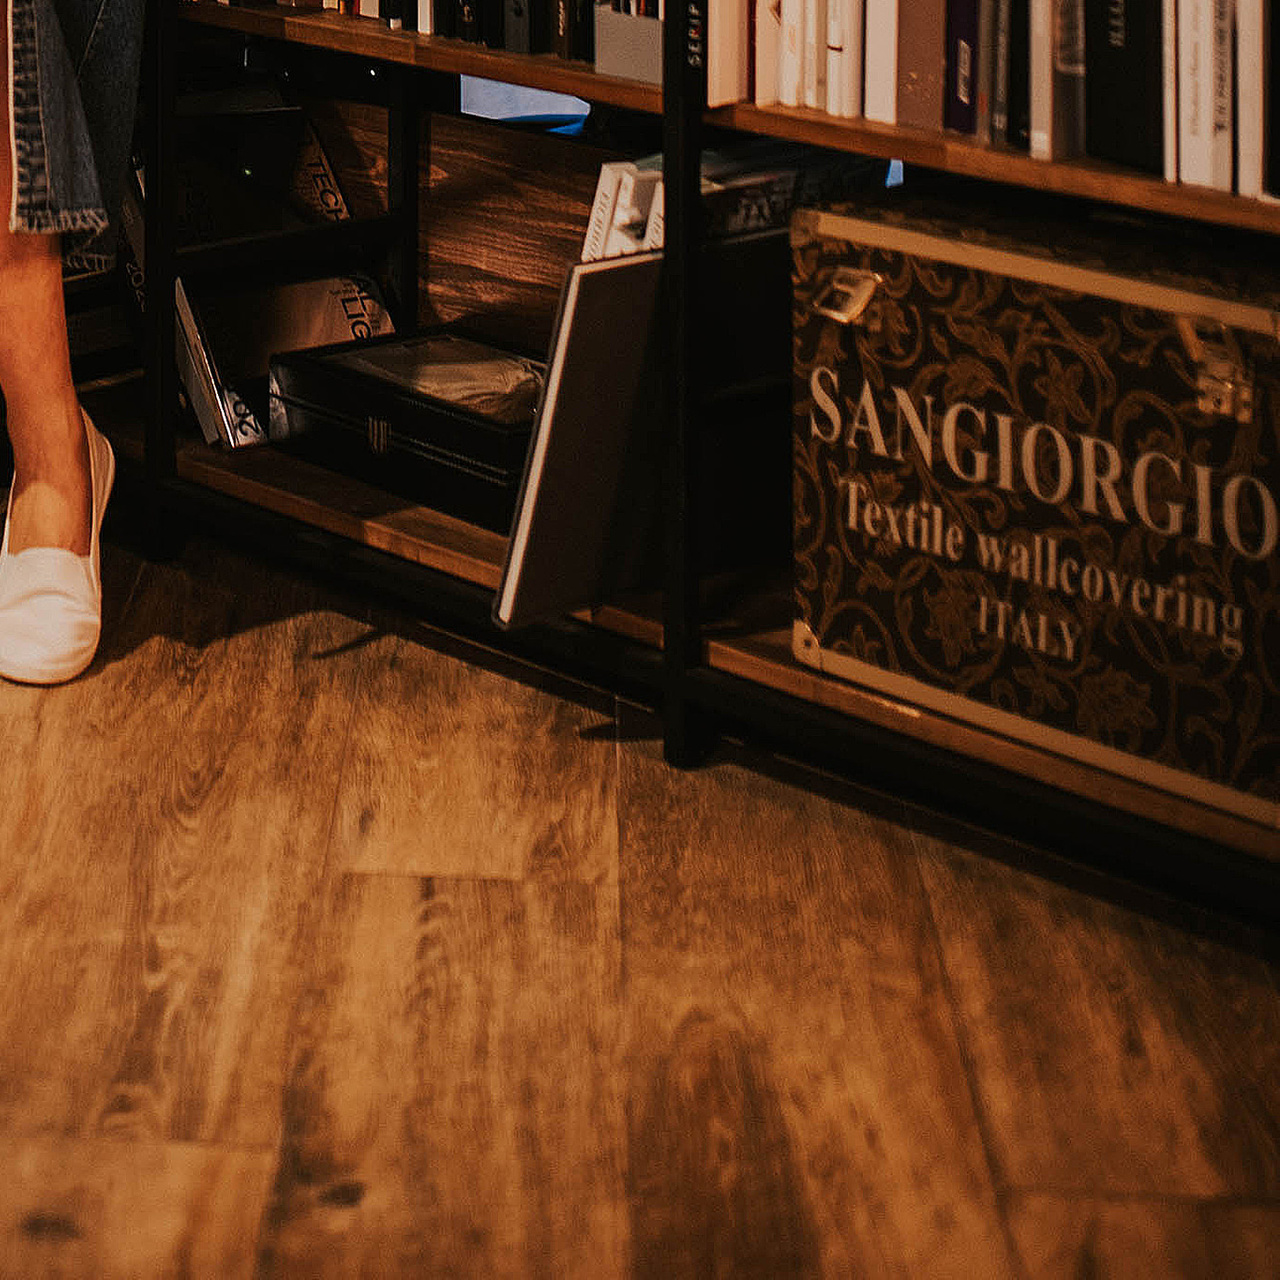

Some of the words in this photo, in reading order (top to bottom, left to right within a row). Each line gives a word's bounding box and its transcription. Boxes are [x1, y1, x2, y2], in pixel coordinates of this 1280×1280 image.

[687, 2, 702, 67] SERIP
[810, 365, 1280, 561] SANGIORGIO
[844, 479, 964, 562] Textile
[977, 528, 1244, 658] wallcovering
[978, 596, 1083, 662] ITALY
